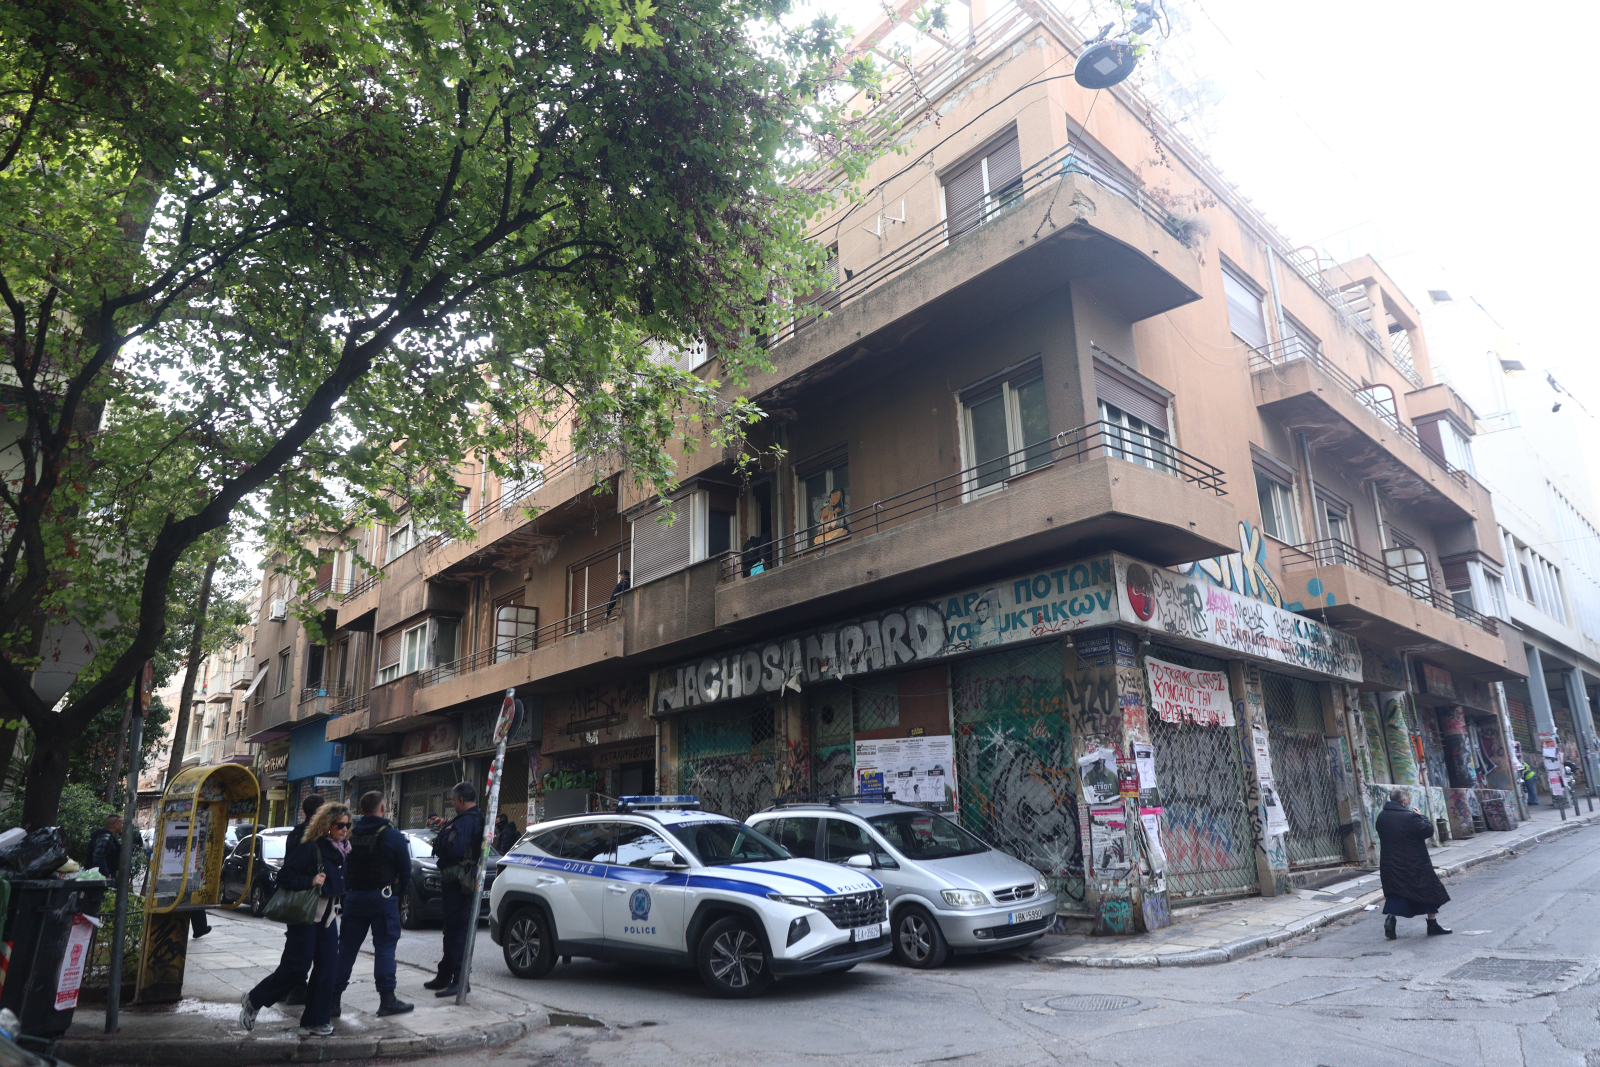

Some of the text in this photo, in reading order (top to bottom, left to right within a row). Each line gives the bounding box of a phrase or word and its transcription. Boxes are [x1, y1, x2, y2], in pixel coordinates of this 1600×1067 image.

[1014, 560, 1111, 604] ΠΟΤΩΝ
[563, 862, 595, 875] ΟΠΚΕ
[837, 882, 874, 893] POLICE
[624, 926, 656, 934] POLICE
